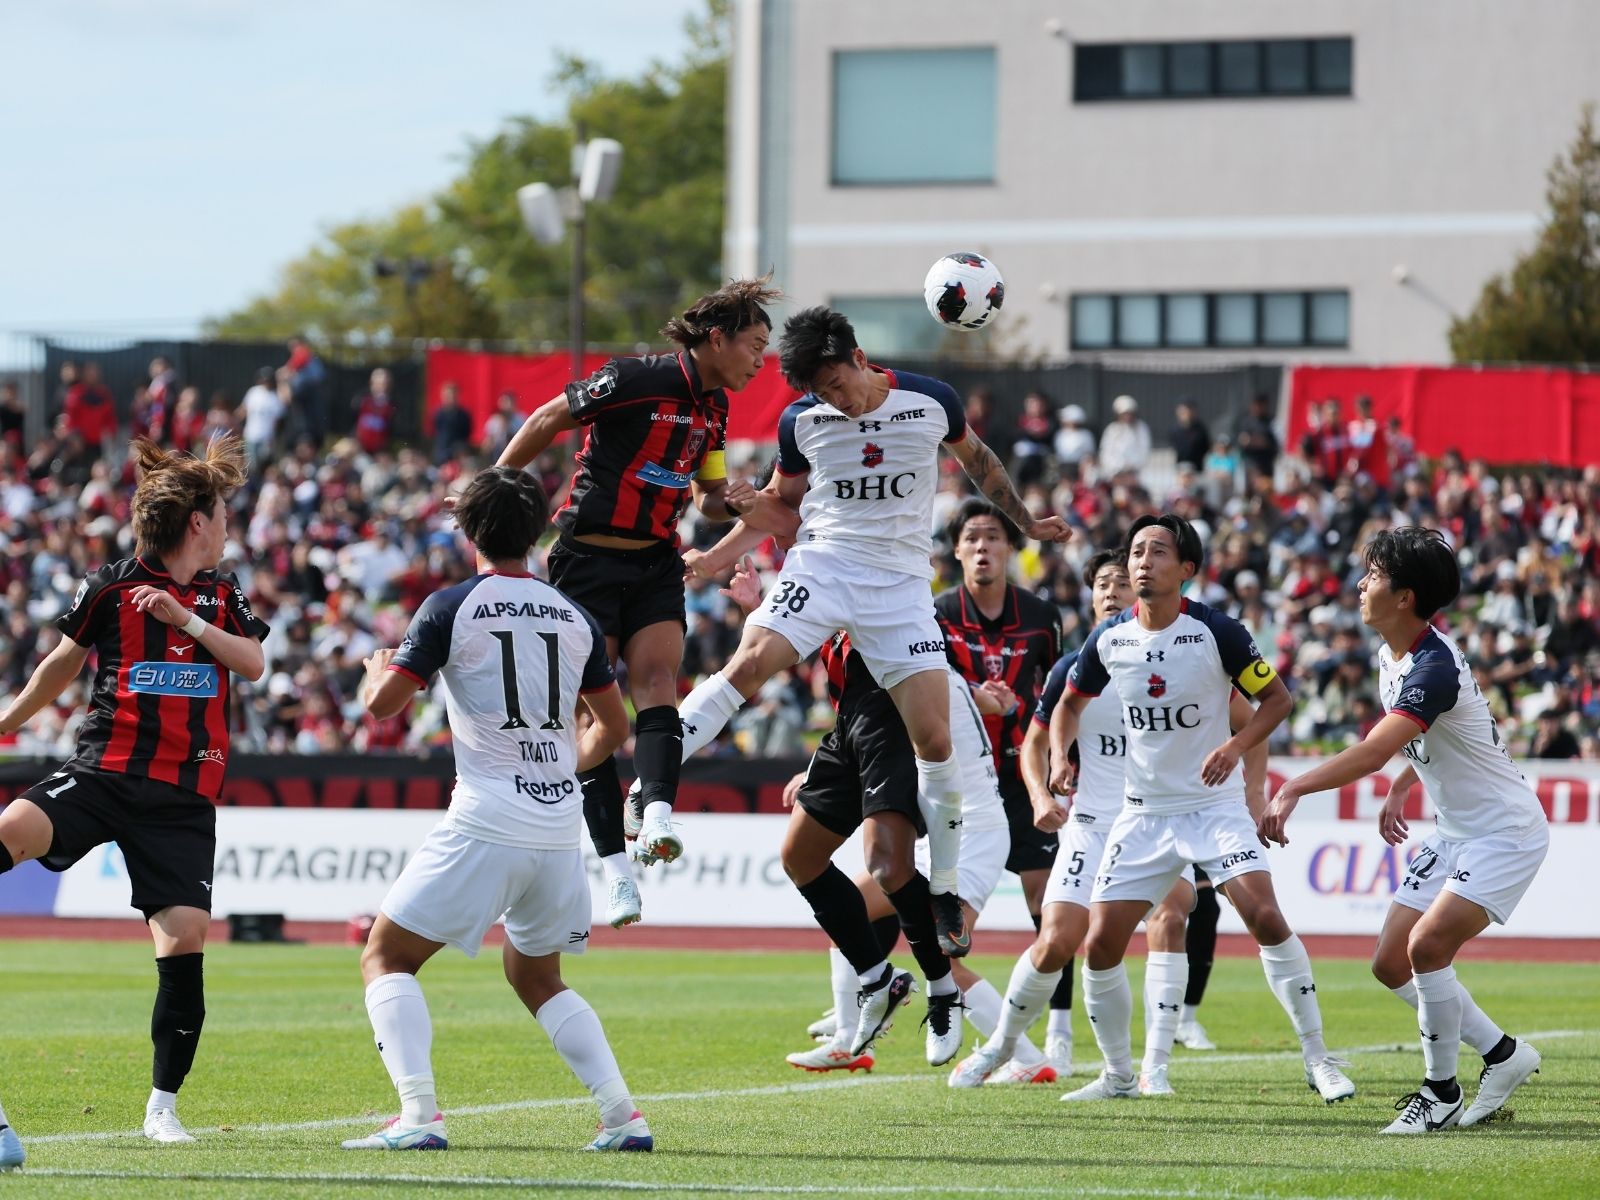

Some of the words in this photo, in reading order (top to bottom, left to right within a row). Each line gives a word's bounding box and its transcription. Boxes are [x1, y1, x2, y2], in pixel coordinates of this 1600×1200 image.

[661, 414, 693, 425] KATAGIRI
[889, 408, 926, 422] ASTEC
[832, 471, 916, 500] BHC
[772, 580, 810, 613] 38
[1173, 634, 1204, 645] ASTEC
[135, 667, 212, 689] 白い恋人
[490, 629, 564, 730] 11
[1254, 660, 1271, 679] C
[1127, 703, 1201, 732] BHC
[215, 847, 408, 882] ATAGIRI
[1067, 850, 1086, 876] 5
[1409, 847, 1439, 880] 22
